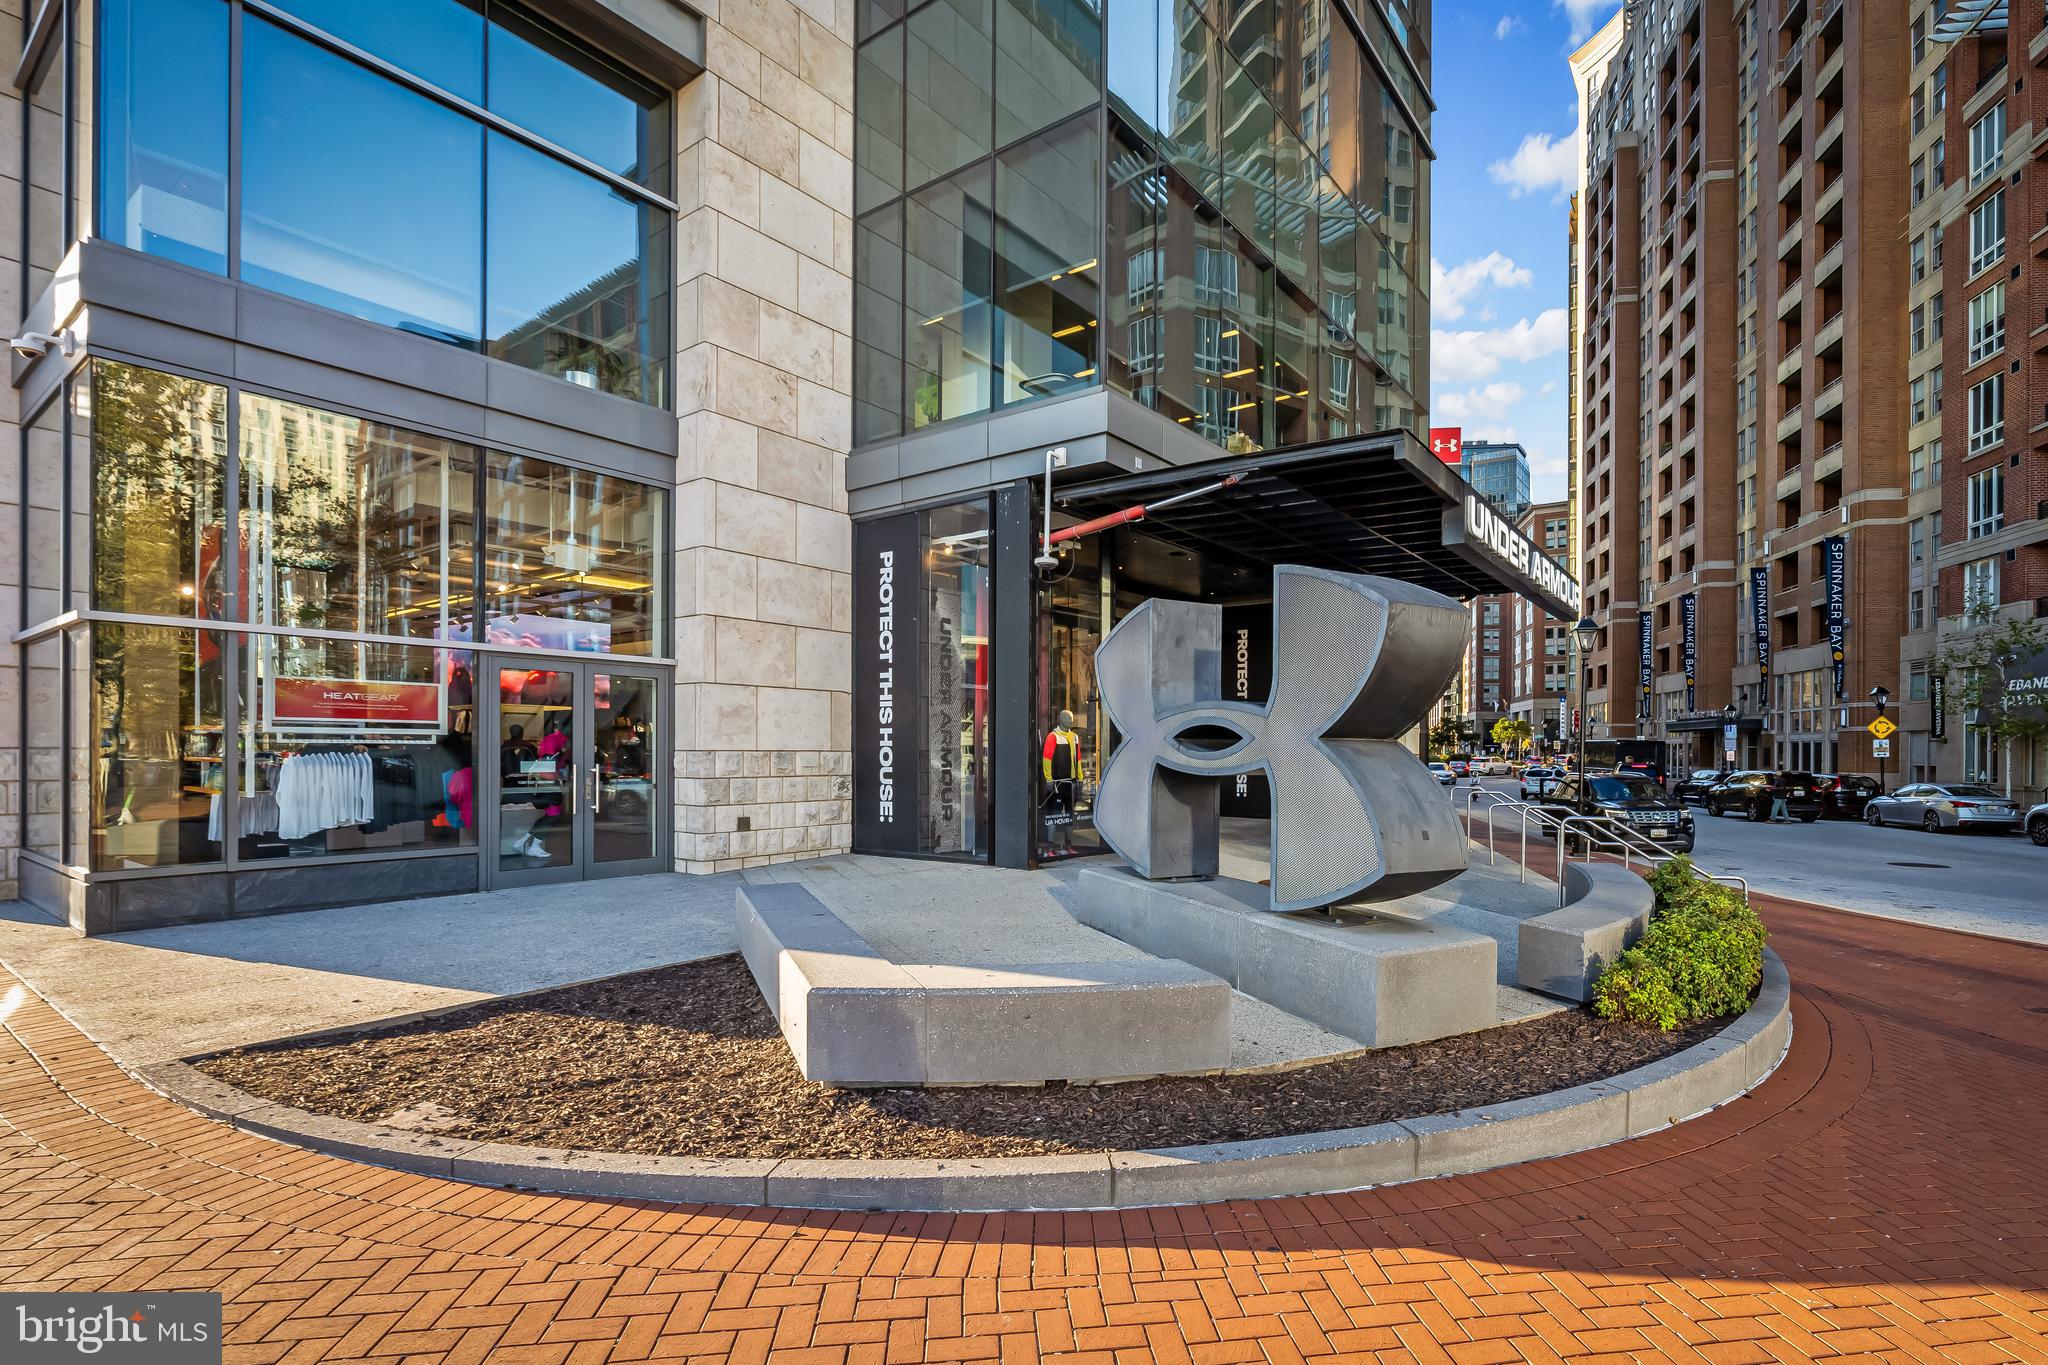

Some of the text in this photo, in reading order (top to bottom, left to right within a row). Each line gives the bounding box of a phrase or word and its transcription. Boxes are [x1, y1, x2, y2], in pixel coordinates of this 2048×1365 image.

[1465, 494, 1529, 575] UNDER
[1756, 572, 1768, 664] SPINNAKER BAY
[1830, 543, 1843, 650] SPINNAKER BAY
[1237, 629, 1249, 699] PROTECT
[1642, 615, 1651, 686] SPINNAKER BAY
[1685, 598, 1696, 678] SPINNAKER BAY
[323, 691, 399, 702] HEATGEAR
[879, 551, 894, 823] PROTECT THIS HOUSE:
[940, 617, 953, 821] UNDER ARMOUR
